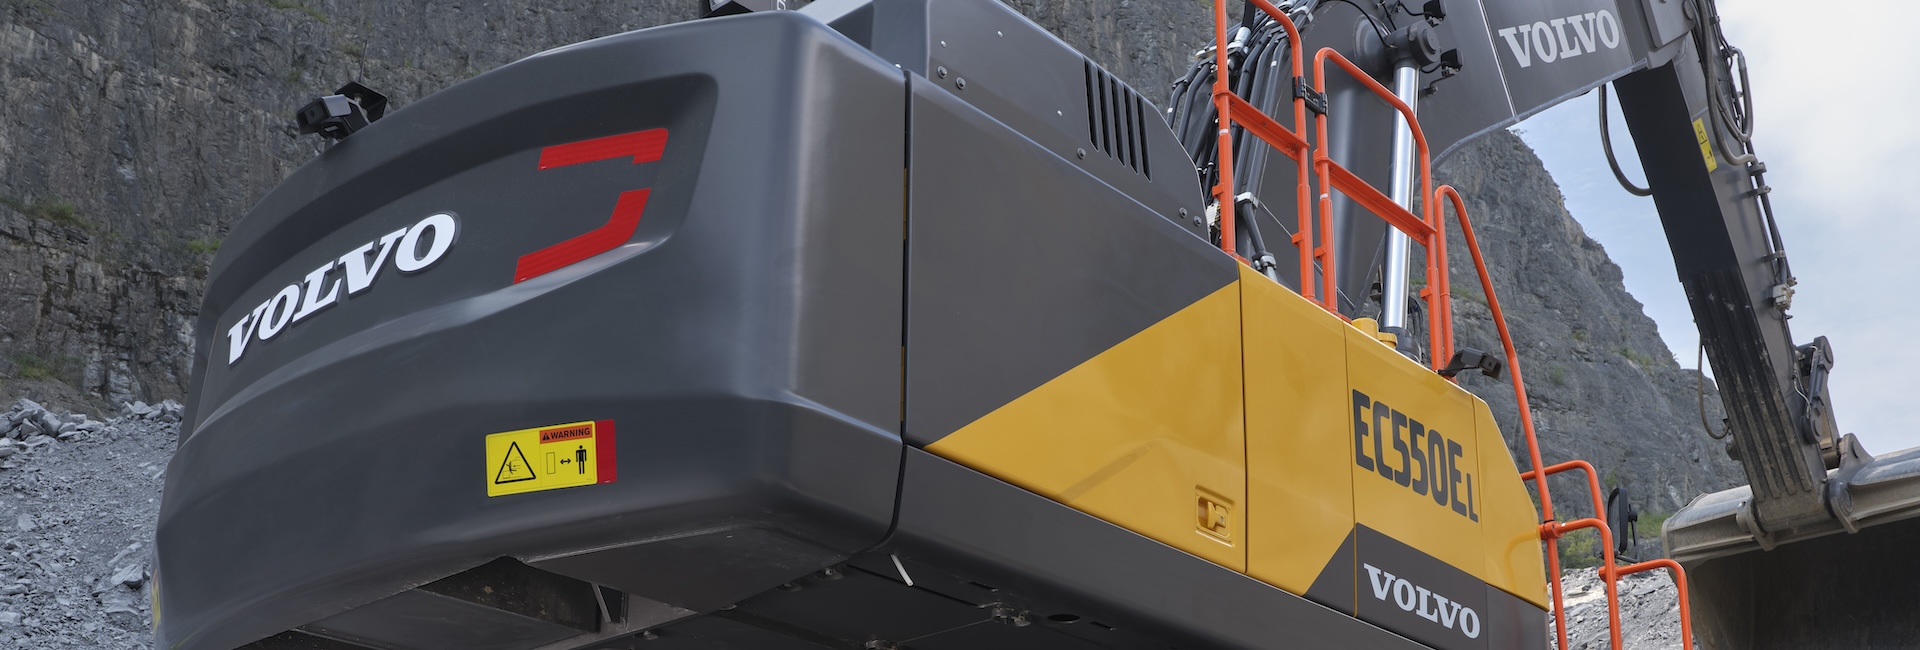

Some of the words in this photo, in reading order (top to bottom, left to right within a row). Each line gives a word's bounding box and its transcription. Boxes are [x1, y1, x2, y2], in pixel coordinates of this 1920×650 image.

[1498, 9, 1620, 68] VOLVO
[227, 213, 458, 365] VOLVO
[550, 427, 591, 440] WARNING
[1363, 562, 1480, 639] VOLVO
